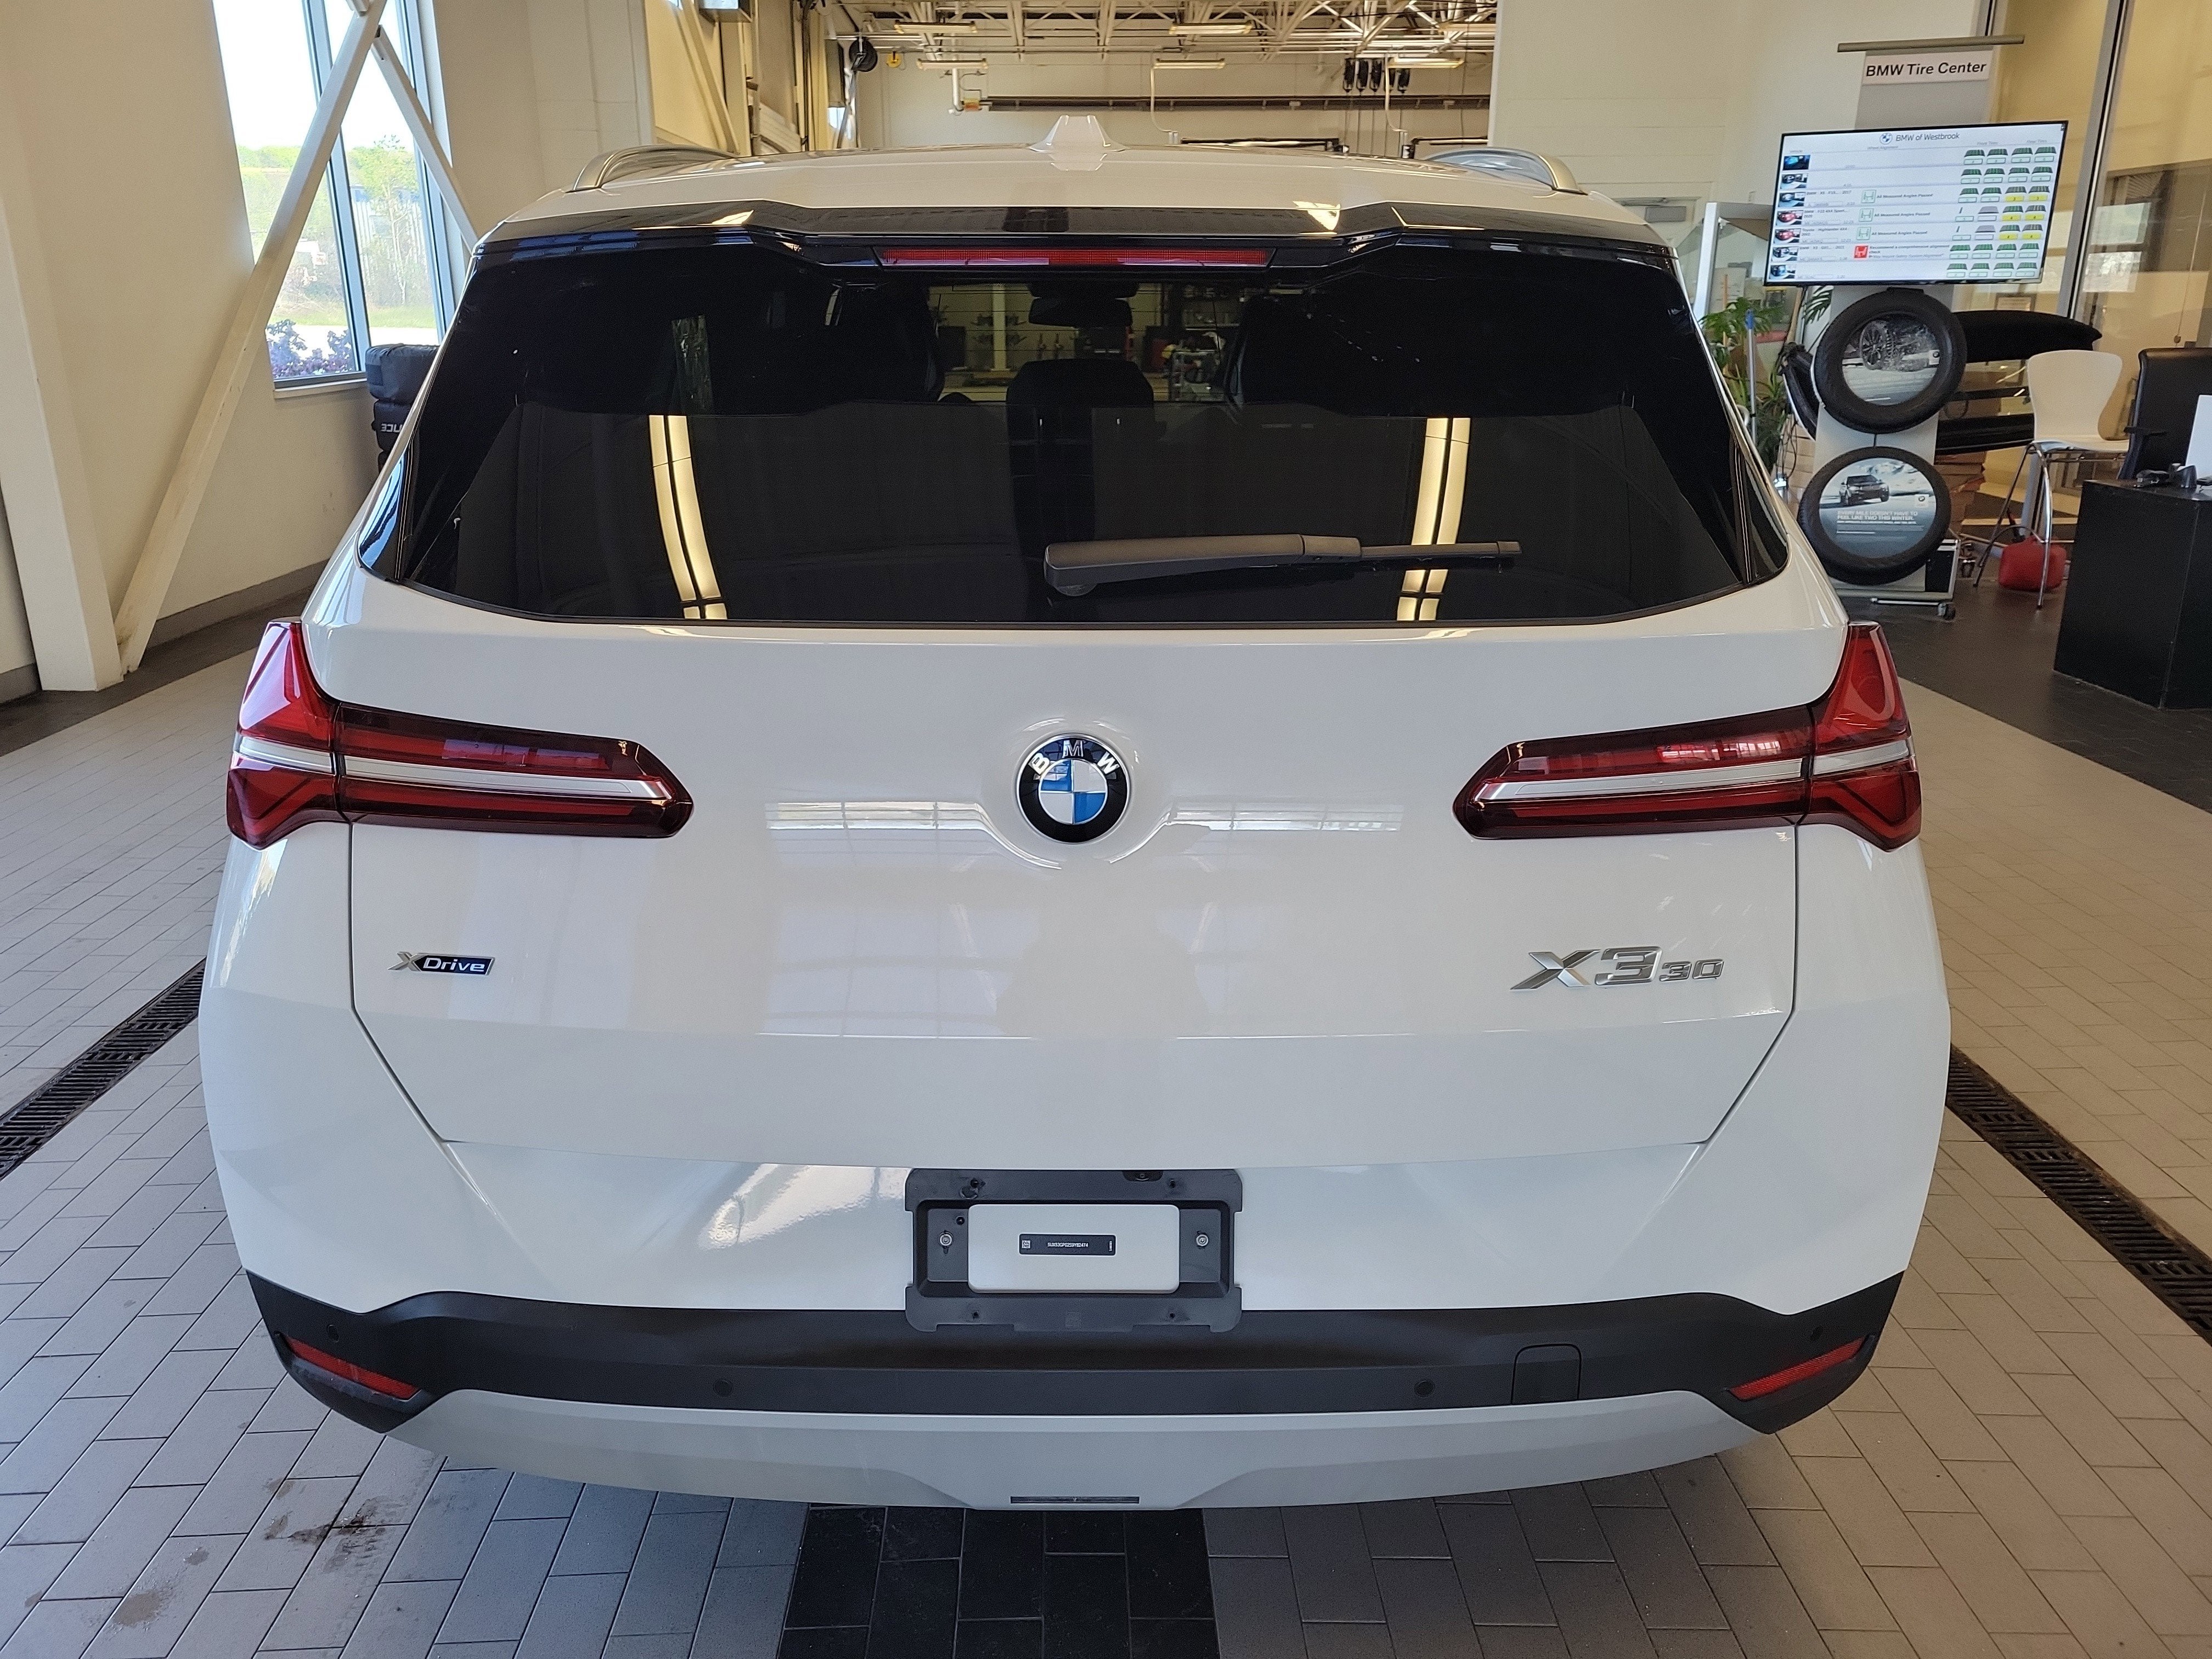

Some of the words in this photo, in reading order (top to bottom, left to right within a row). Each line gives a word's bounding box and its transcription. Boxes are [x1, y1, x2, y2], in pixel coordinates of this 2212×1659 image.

[1866, 64, 1904, 77] BMW
[1907, 63, 1934, 75] Tire
[1938, 62, 1987, 74] Center
[1924, 132, 1960, 140] Westbrook
[1028, 740, 1121, 775] BMW
[1510, 946, 1662, 990] X3
[1659, 958, 1725, 982] 30
